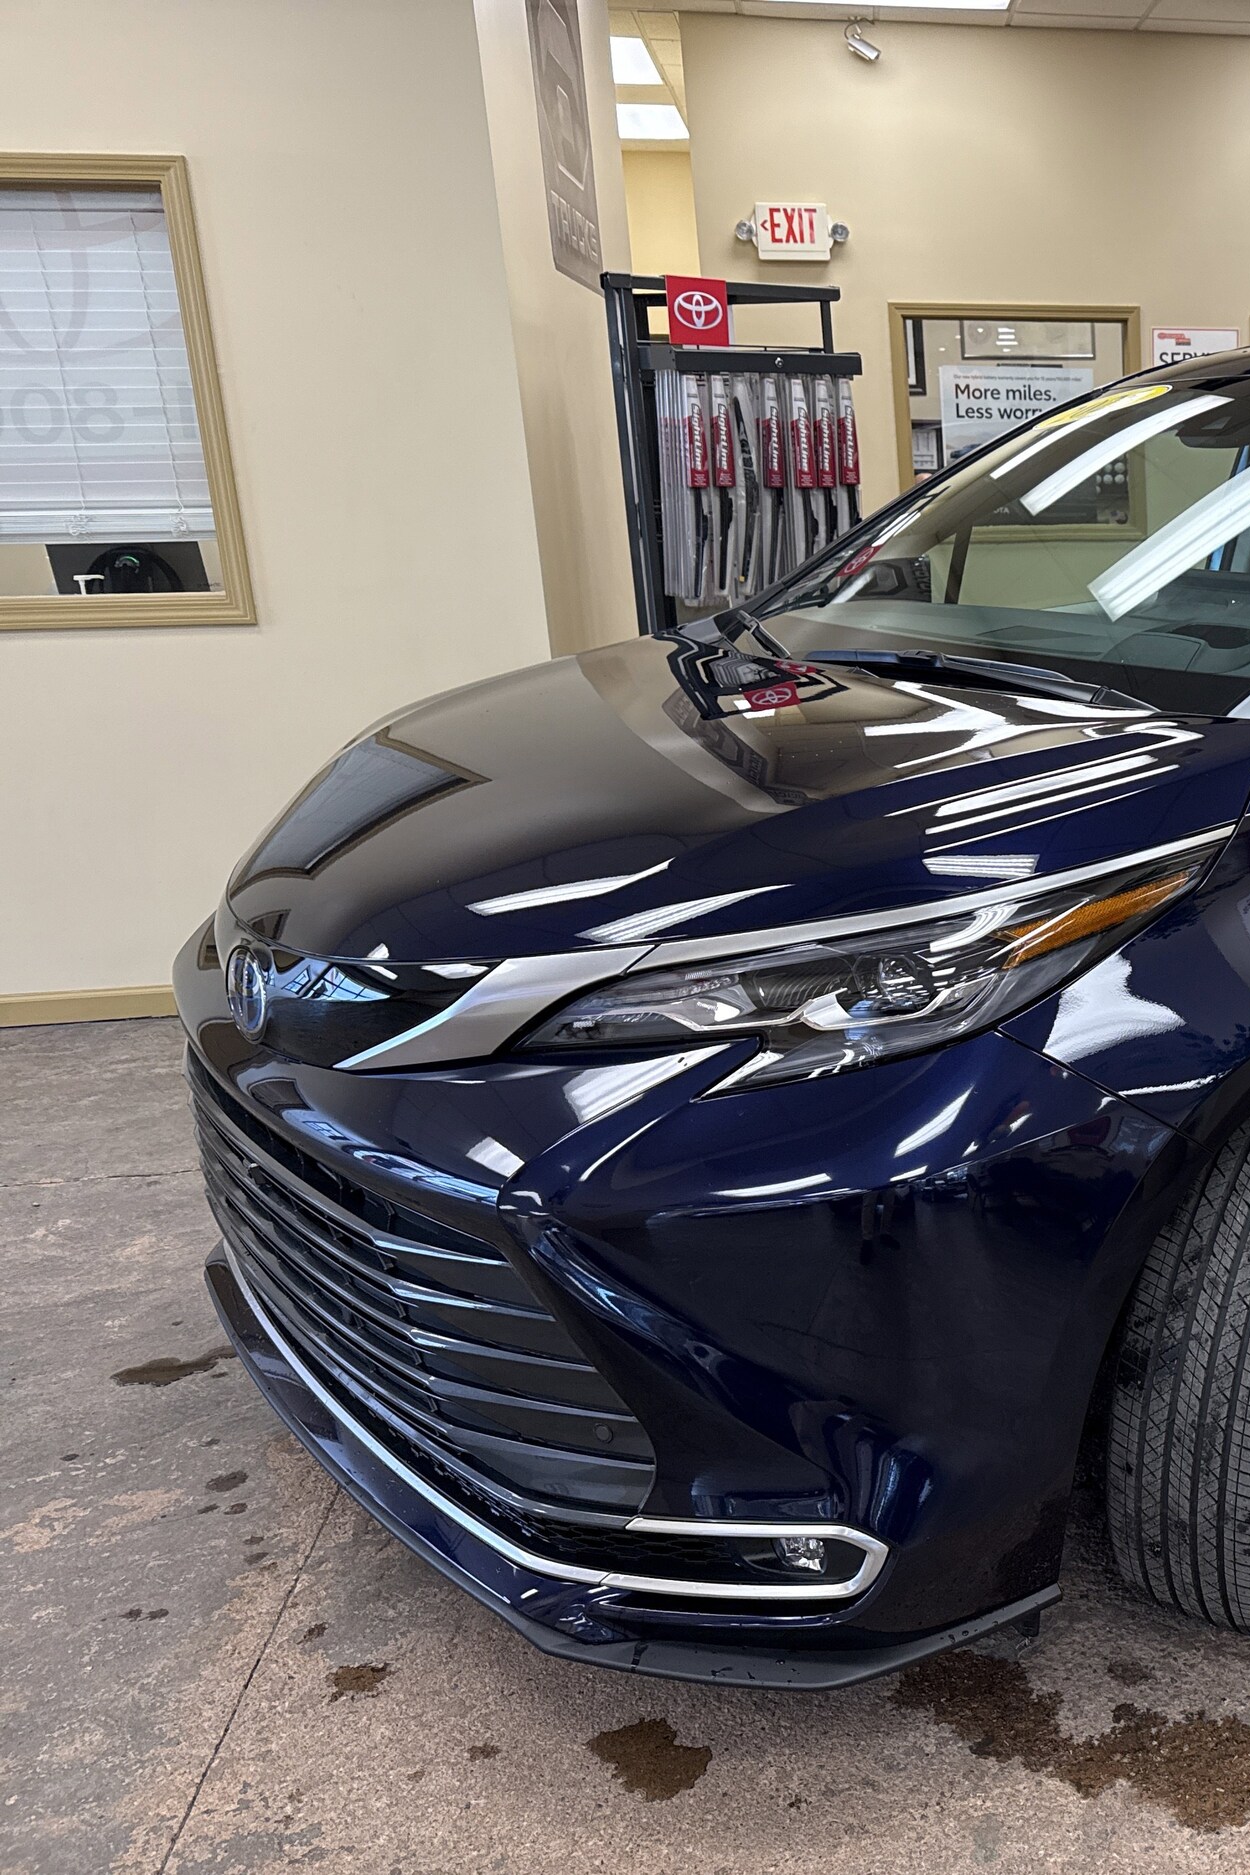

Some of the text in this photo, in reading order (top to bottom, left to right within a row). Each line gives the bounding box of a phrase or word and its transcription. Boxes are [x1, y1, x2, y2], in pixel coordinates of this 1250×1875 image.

[768, 207, 817, 244] EXIT
[955, 384, 1056, 402] More miles.
[956, 402, 1042, 420] Less worr
